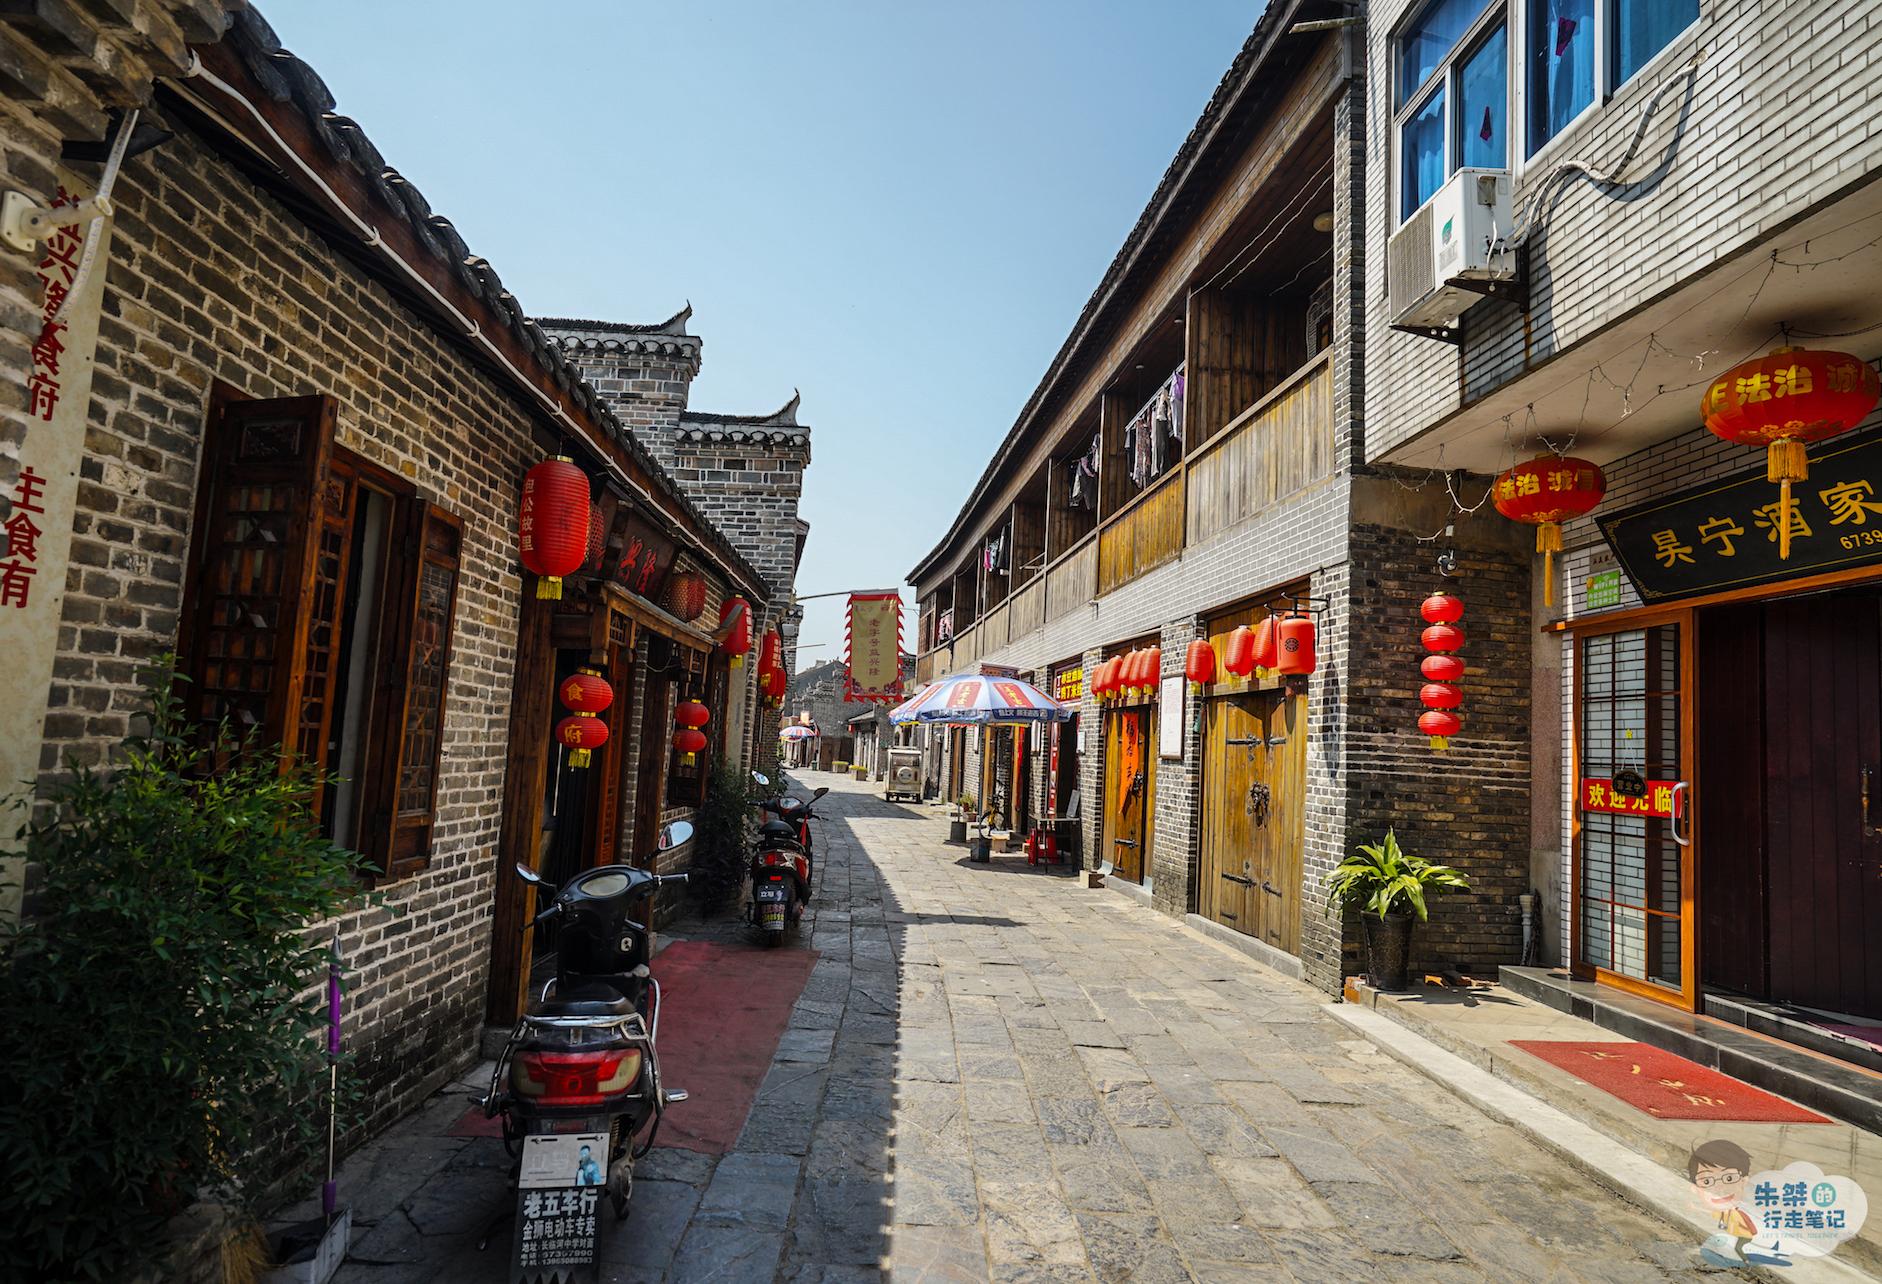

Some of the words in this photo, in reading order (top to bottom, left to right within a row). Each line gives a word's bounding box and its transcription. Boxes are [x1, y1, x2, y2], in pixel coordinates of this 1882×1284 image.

[521, 479, 535, 552] 包公故里
[0, 466, 46, 609] 主食有
[1840, 529, 1882, 550] 6739
[566, 682, 584, 702] 食
[564, 724, 583, 744] 府
[523, 1188, 598, 1219] 老五车行
[522, 1215, 596, 1241] 金狮电动车专卖
